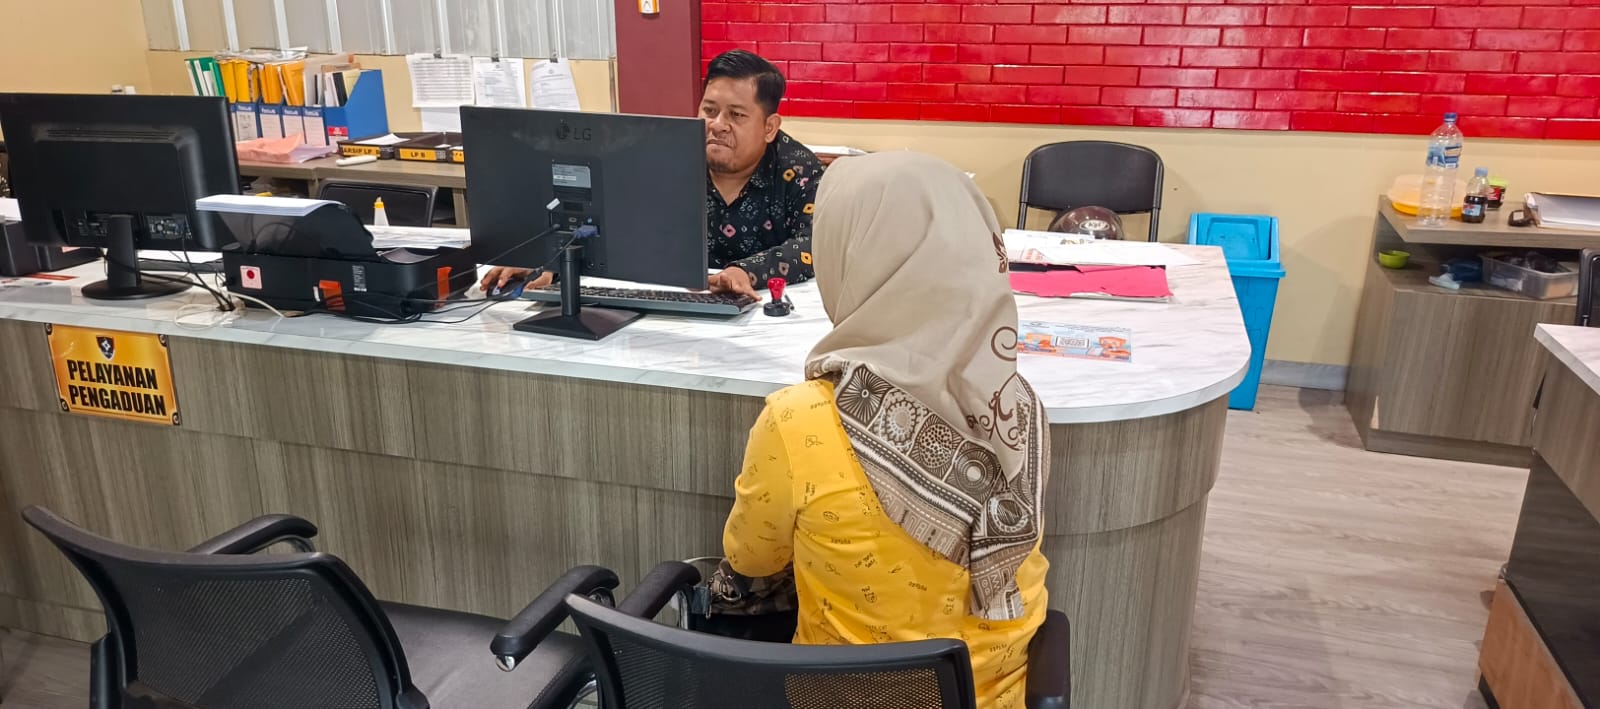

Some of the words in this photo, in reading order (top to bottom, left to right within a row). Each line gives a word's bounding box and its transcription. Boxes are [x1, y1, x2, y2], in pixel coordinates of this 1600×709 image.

[574, 128, 592, 140] LG
[66, 359, 158, 390] PELAYANAN
[68, 384, 167, 416] PENGADUAN
